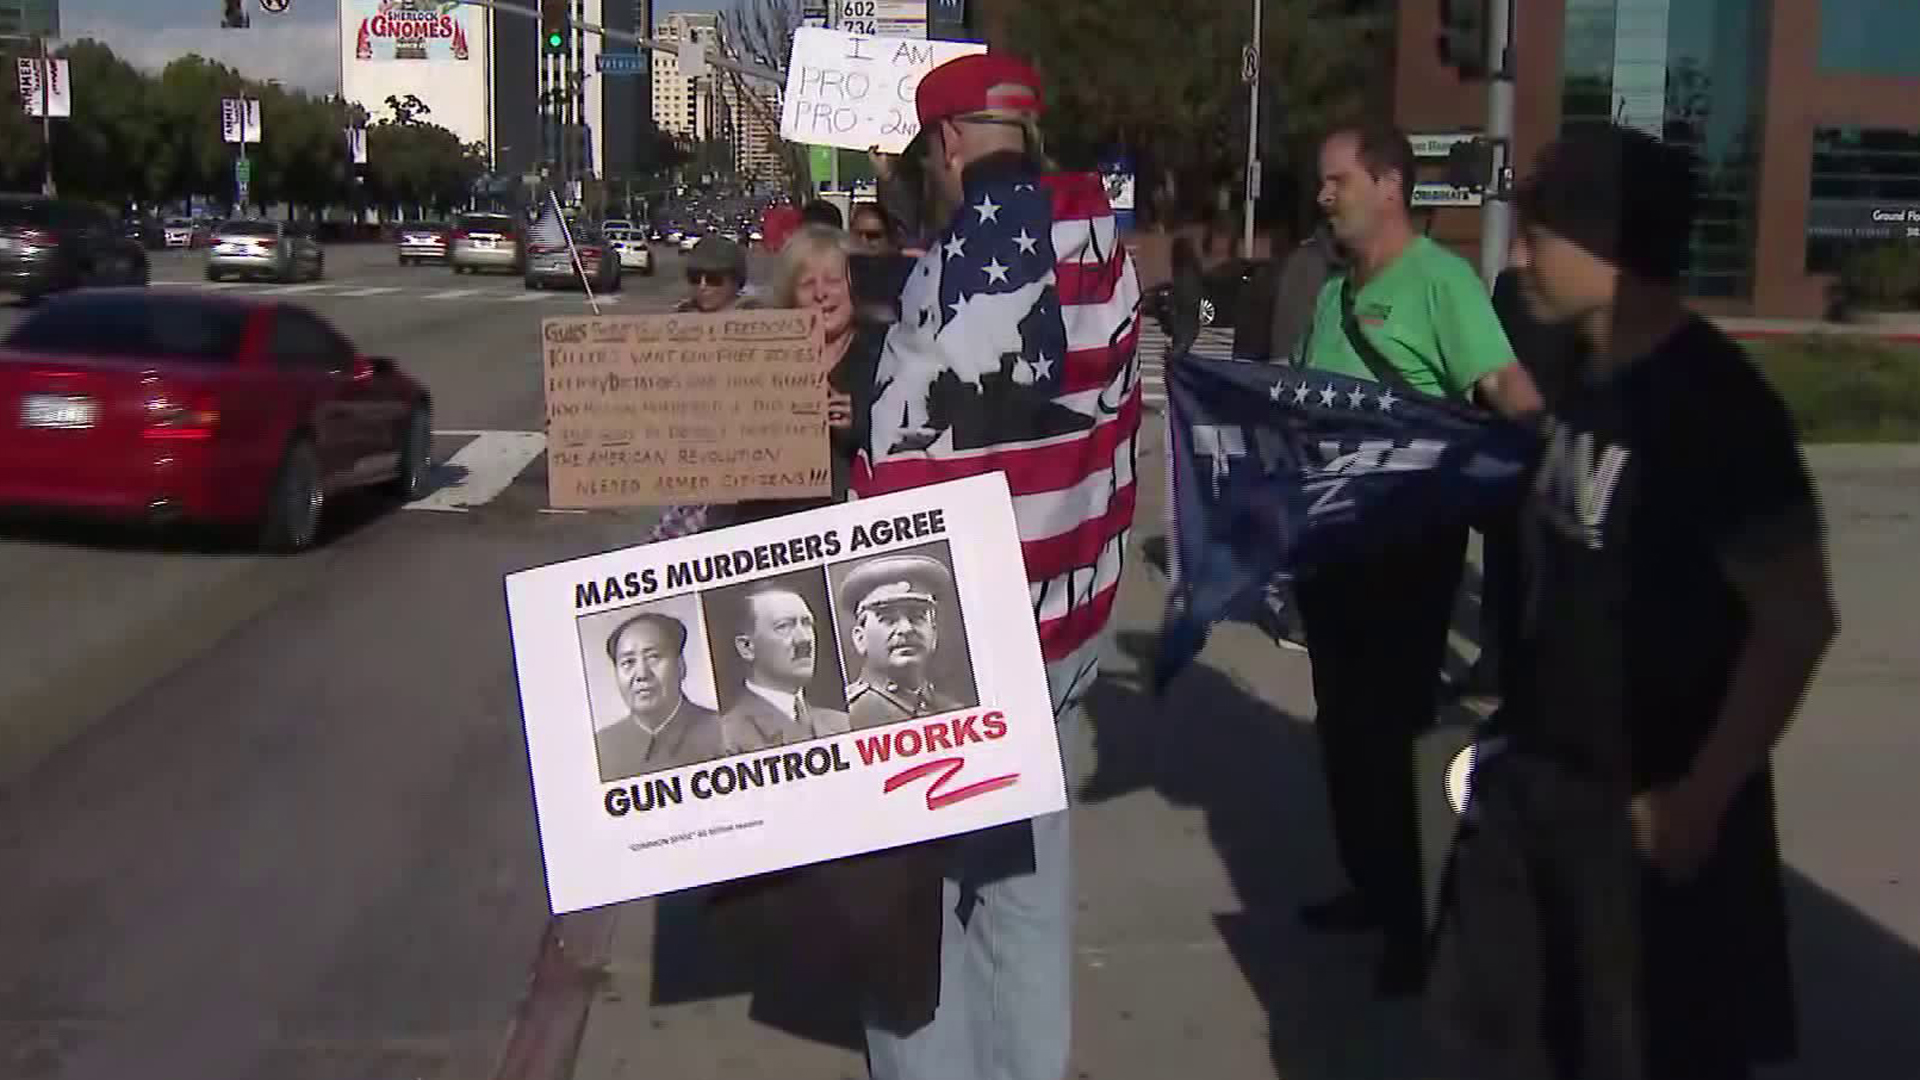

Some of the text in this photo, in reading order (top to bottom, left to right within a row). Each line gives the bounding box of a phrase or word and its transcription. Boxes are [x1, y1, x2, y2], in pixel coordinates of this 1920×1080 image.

[388, 10, 438, 21] SHERLOCK
[844, 1, 875, 16] 602
[371, 14, 452, 38] GNOMES
[844, 20, 876, 35] 734
[846, 37, 934, 68] I AM
[799, 66, 870, 100] PRO
[794, 100, 857, 134] PRO
[1872, 208, 1906, 222] Ground
[575, 507, 947, 610] MASS MURDERERS AGREE
[603, 710, 1009, 818] GUN CONTROL WORKS
